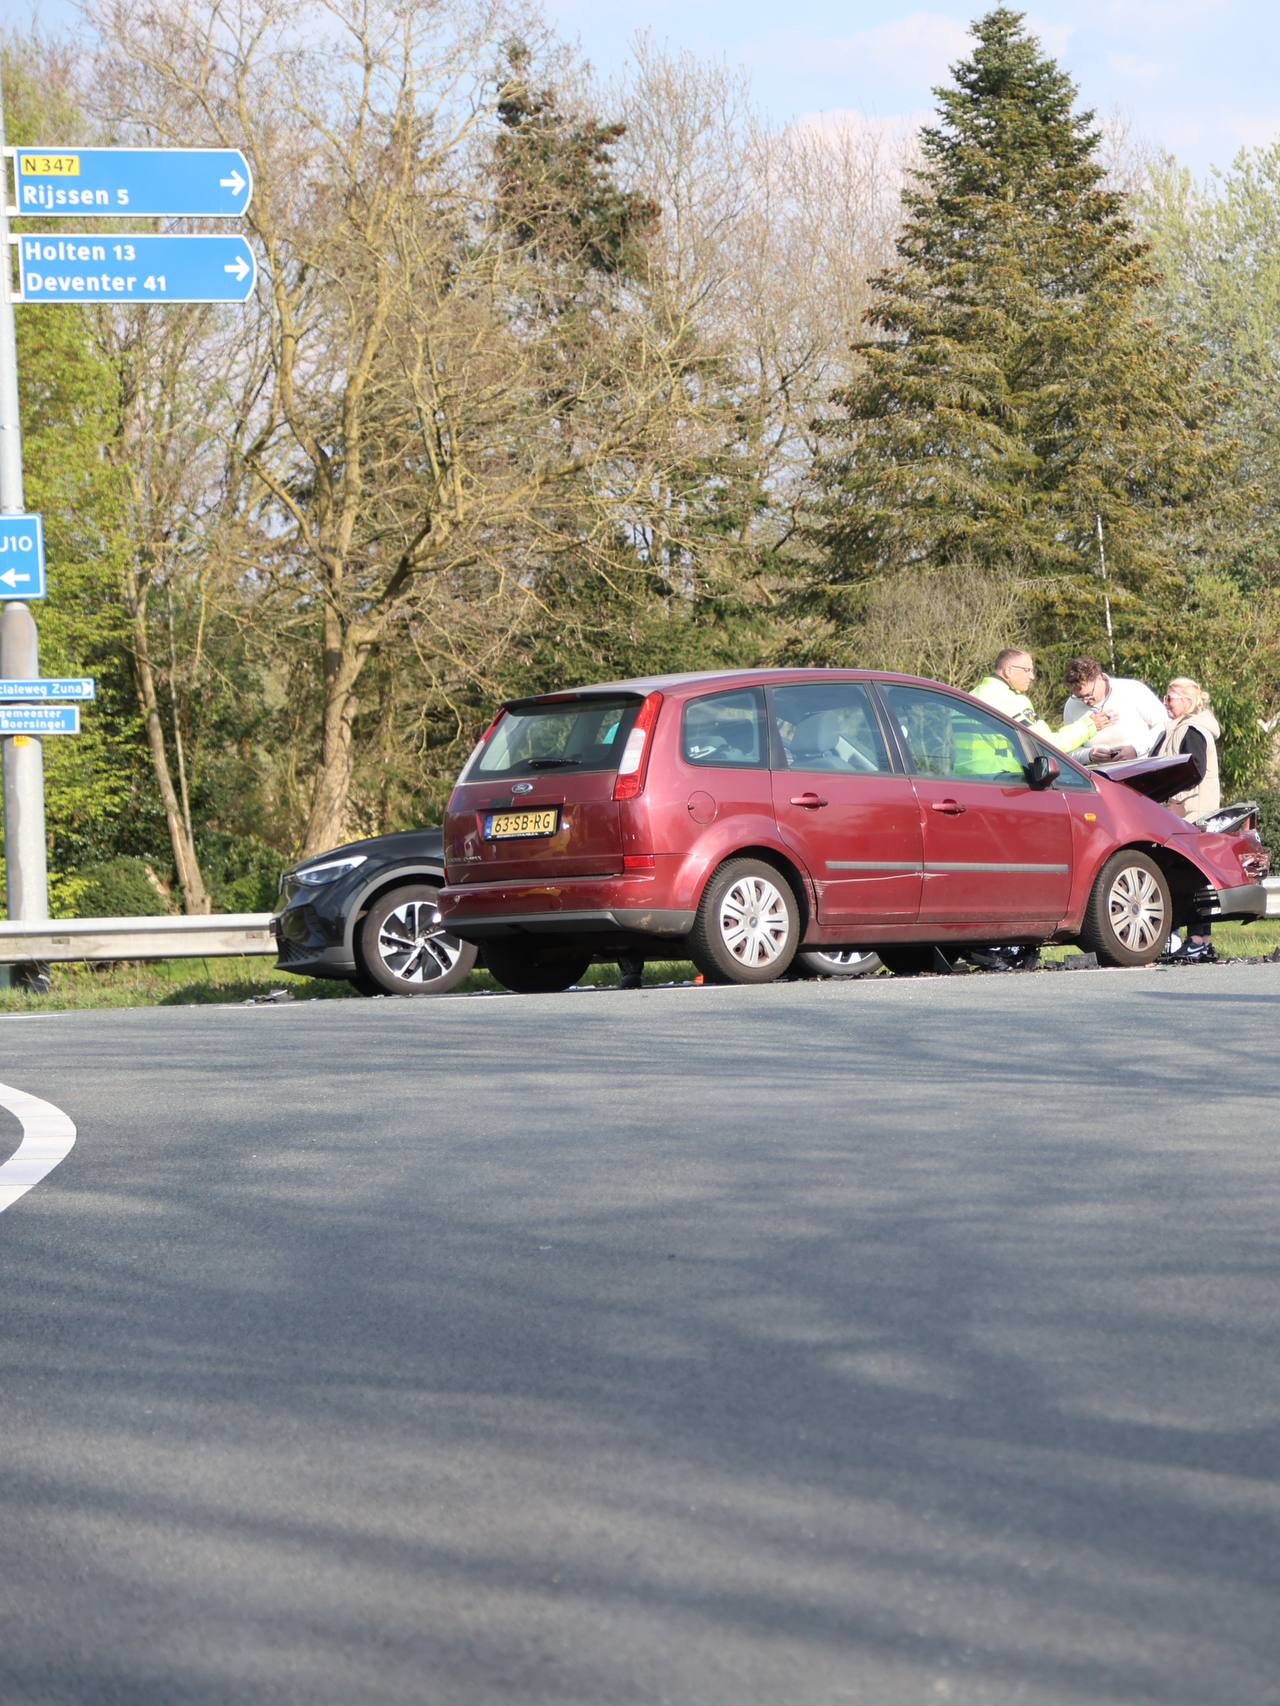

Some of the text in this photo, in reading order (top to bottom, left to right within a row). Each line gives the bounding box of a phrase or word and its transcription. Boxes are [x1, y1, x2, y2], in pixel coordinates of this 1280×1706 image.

[23, 185, 129, 209] Rijssen 5
[25, 242, 136, 261] Holten 13
[27, 273, 167, 292] Deventer 41
[52, 683, 82, 694] Zuna
[494, 813, 551, 833] 63-SB-RG
